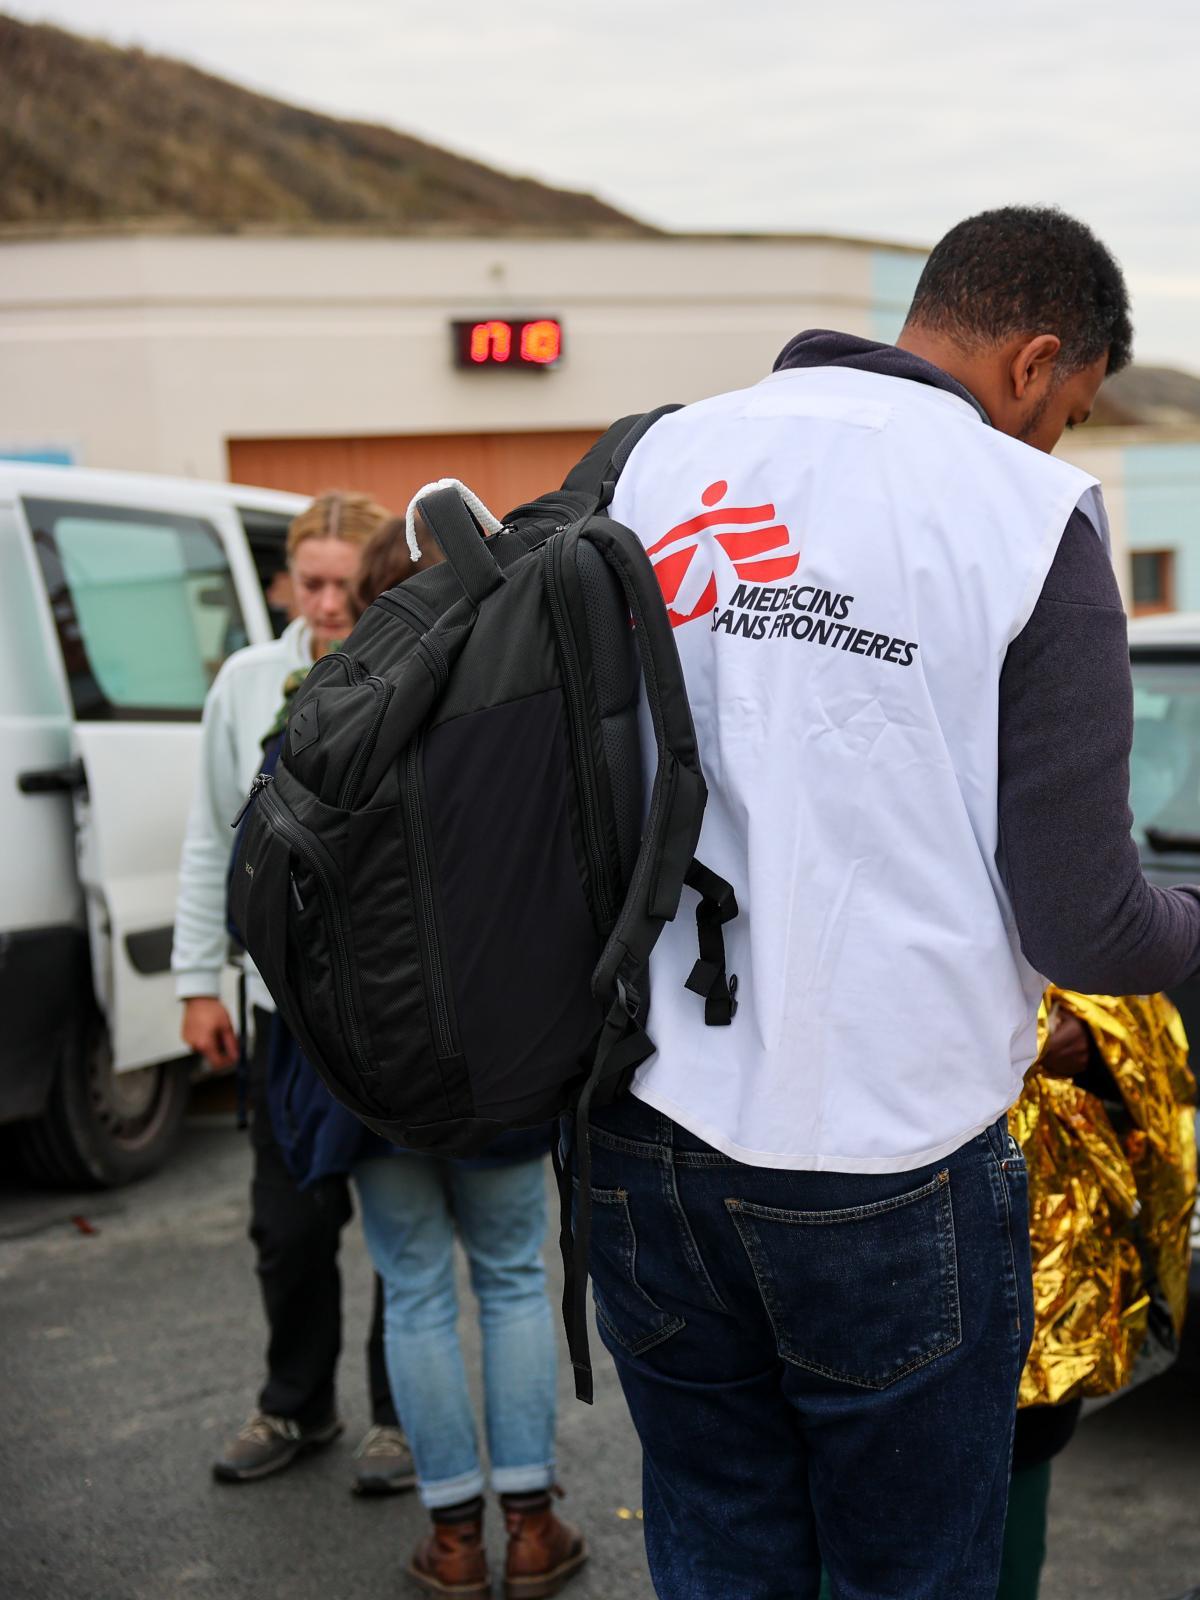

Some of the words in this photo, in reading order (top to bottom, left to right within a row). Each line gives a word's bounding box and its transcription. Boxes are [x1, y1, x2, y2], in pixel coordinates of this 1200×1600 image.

[729, 584, 854, 619] MEDECINS
[711, 607, 770, 640] SANS
[768, 613, 918, 667] FRONTIERES
